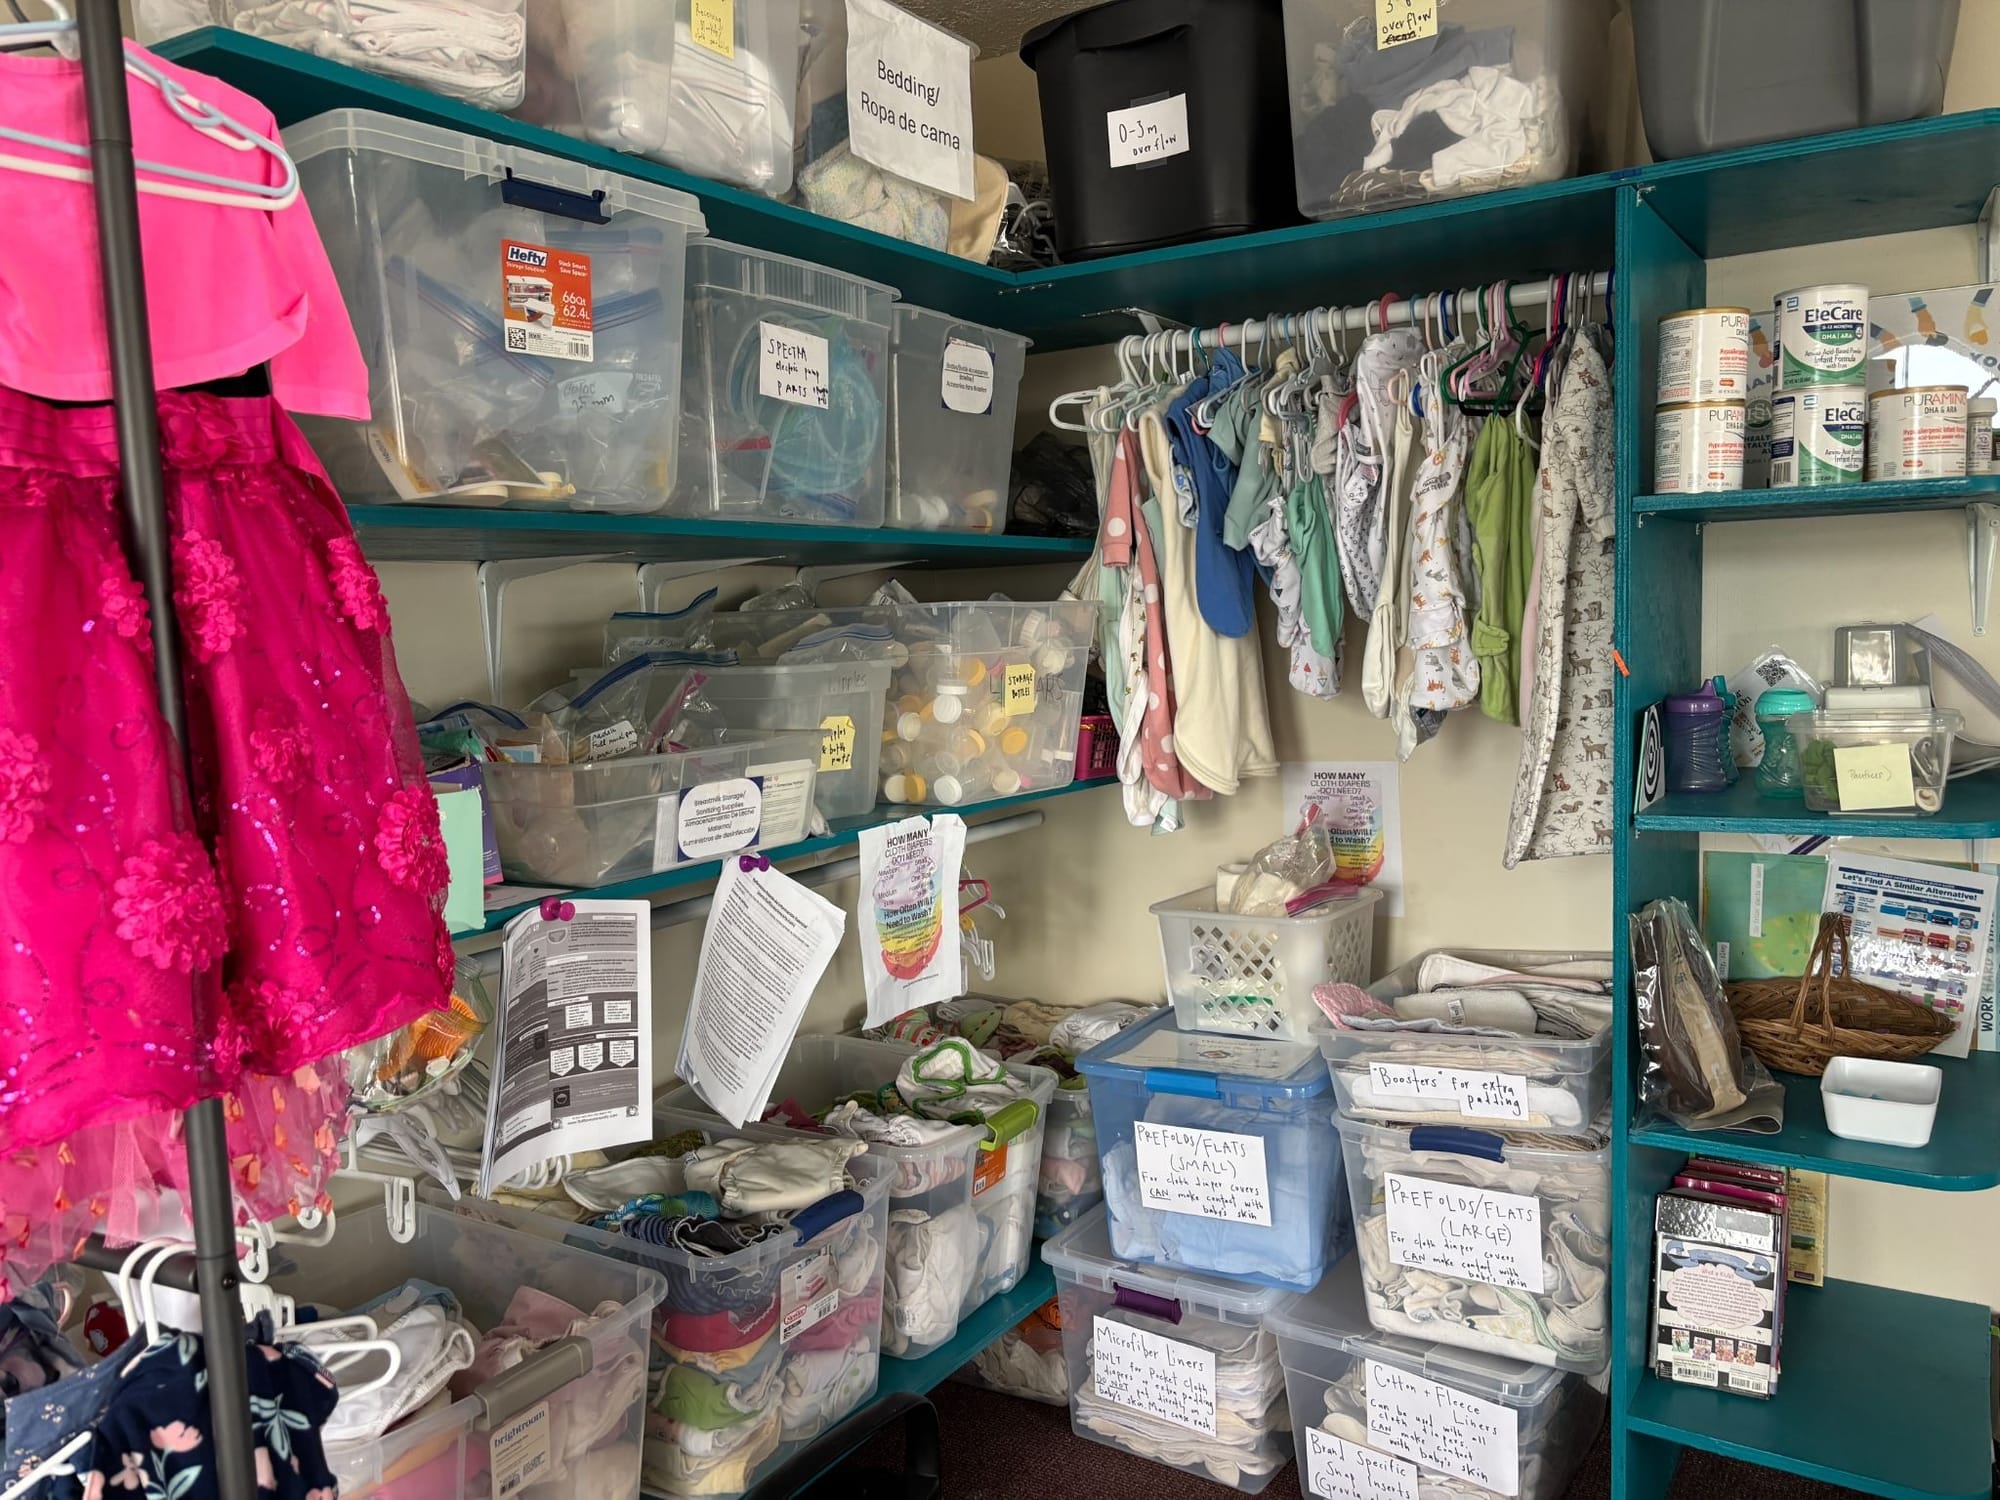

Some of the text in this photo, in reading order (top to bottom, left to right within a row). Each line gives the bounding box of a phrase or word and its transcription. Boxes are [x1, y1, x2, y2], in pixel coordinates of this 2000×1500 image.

[1382, 8, 1431, 34] overflow
[877, 59, 941, 107] Bedding/
[861, 91, 960, 151] Ropa de cama
[1132, 133, 1177, 156] overflow
[509, 247, 547, 266] Hefty
[560, 267, 571, 275] Save
[1804, 306, 1863, 323] EleCare
[1924, 405, 1958, 415] DHA & ARA
[1008, 672, 1033, 686] STORAGE
[1314, 772, 1366, 780] HOW MANY
[1338, 780, 1371, 788] DIAPERS
[1337, 787, 1362, 795] NEED?
[885, 837, 933, 858] CLOTH DIAPERS
[887, 828, 929, 848] HOW MANY
[1344, 836, 1371, 844] Wash?
[1842, 873, 1863, 882] Let's
[1865, 877, 1883, 885] Find
[1894, 881, 1924, 892] Similar
[1925, 885, 1978, 902] Alternative!
[883, 908, 899, 919] How
[900, 902, 917, 913] Often
[886, 908, 932, 930] Need to Wash?
[1981, 995, 1993, 1032] WORK
[1451, 1076, 1470, 1091] for
[1481, 1075, 1515, 1099] extra
[1467, 1091, 1521, 1117] padding
[1170, 1154, 1237, 1179] (SMALL)
[1142, 1171, 1260, 1197] For cloth diaper covers
[1149, 1187, 1264, 1210] CAN make contact with
[1202, 1204, 1258, 1220] baby's skin
[1440, 1215, 1512, 1247] (LARGE)
[1390, 1230, 1515, 1263] For cloth diaper covers
[1402, 1249, 1520, 1278] CAN make contact with
[1468, 1269, 1528, 1289] baby's skin
[1097, 1326, 1205, 1372] Microfiber Liners
[1129, 1361, 1142, 1373] for
[1148, 1366, 1179, 1386] Pocket
[1096, 1373, 1107, 1384] DO
[1109, 1379, 1129, 1391] NOT
[1136, 1388, 1150, 1400] put
[1190, 1408, 1200, 1416] on
[1103, 1364, 1134, 1382] diapers
[1155, 1382, 1178, 1397] extra
[1182, 1391, 1215, 1416] padding
[1373, 1364, 1481, 1416] Cotton + Fleece
[1148, 1400, 1167, 1418] May
[1170, 1411, 1190, 1423] cause
[1193, 1417, 1216, 1433] rash.
[1378, 1411, 1408, 1428] cloth
[1395, 1404, 1408, 1417] be
[1415, 1413, 1434, 1428] used
[1443, 1425, 1463, 1438] with
[1471, 1435, 1487, 1446] all
[1452, 1409, 1498, 1436] Liners
[1371, 1419, 1474, 1462] CAN make contact
[1310, 1432, 1407, 1482] Brand Specific
[1389, 1438, 1410, 1452] with
[1461, 1462, 1489, 1484] skin
[1325, 1460, 1356, 1489] Snap
